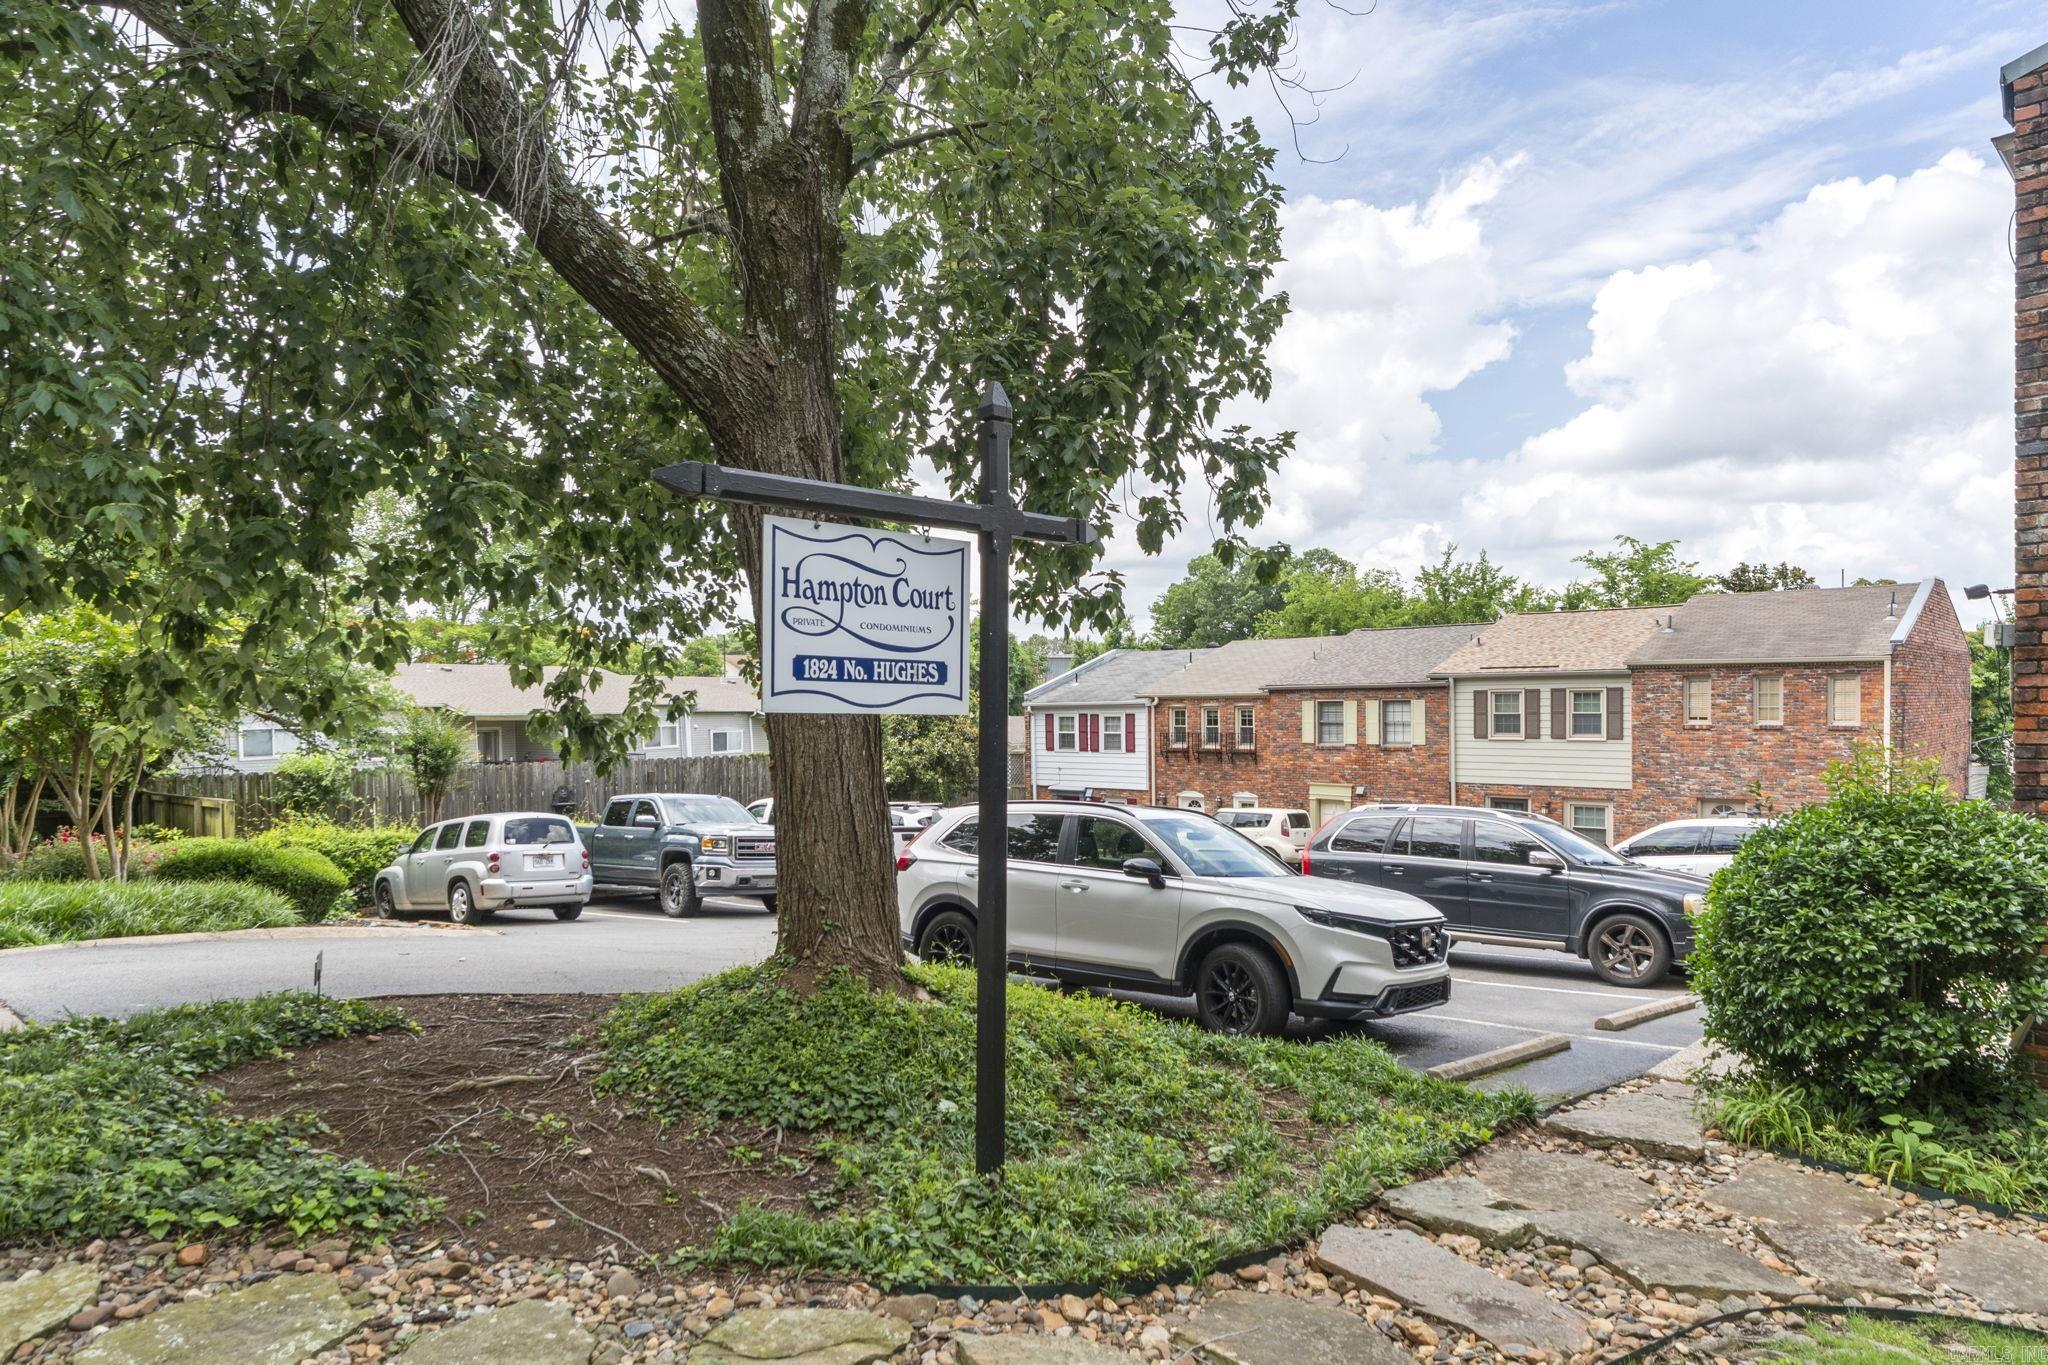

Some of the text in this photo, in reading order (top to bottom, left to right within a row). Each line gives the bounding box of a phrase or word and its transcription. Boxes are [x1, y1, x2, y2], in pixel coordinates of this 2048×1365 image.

[781, 560, 956, 611] Hampton Court
[792, 617, 932, 634] PRIVATE CONDOMINIUMS
[803, 658, 939, 683] 1824 No. HUGHES
